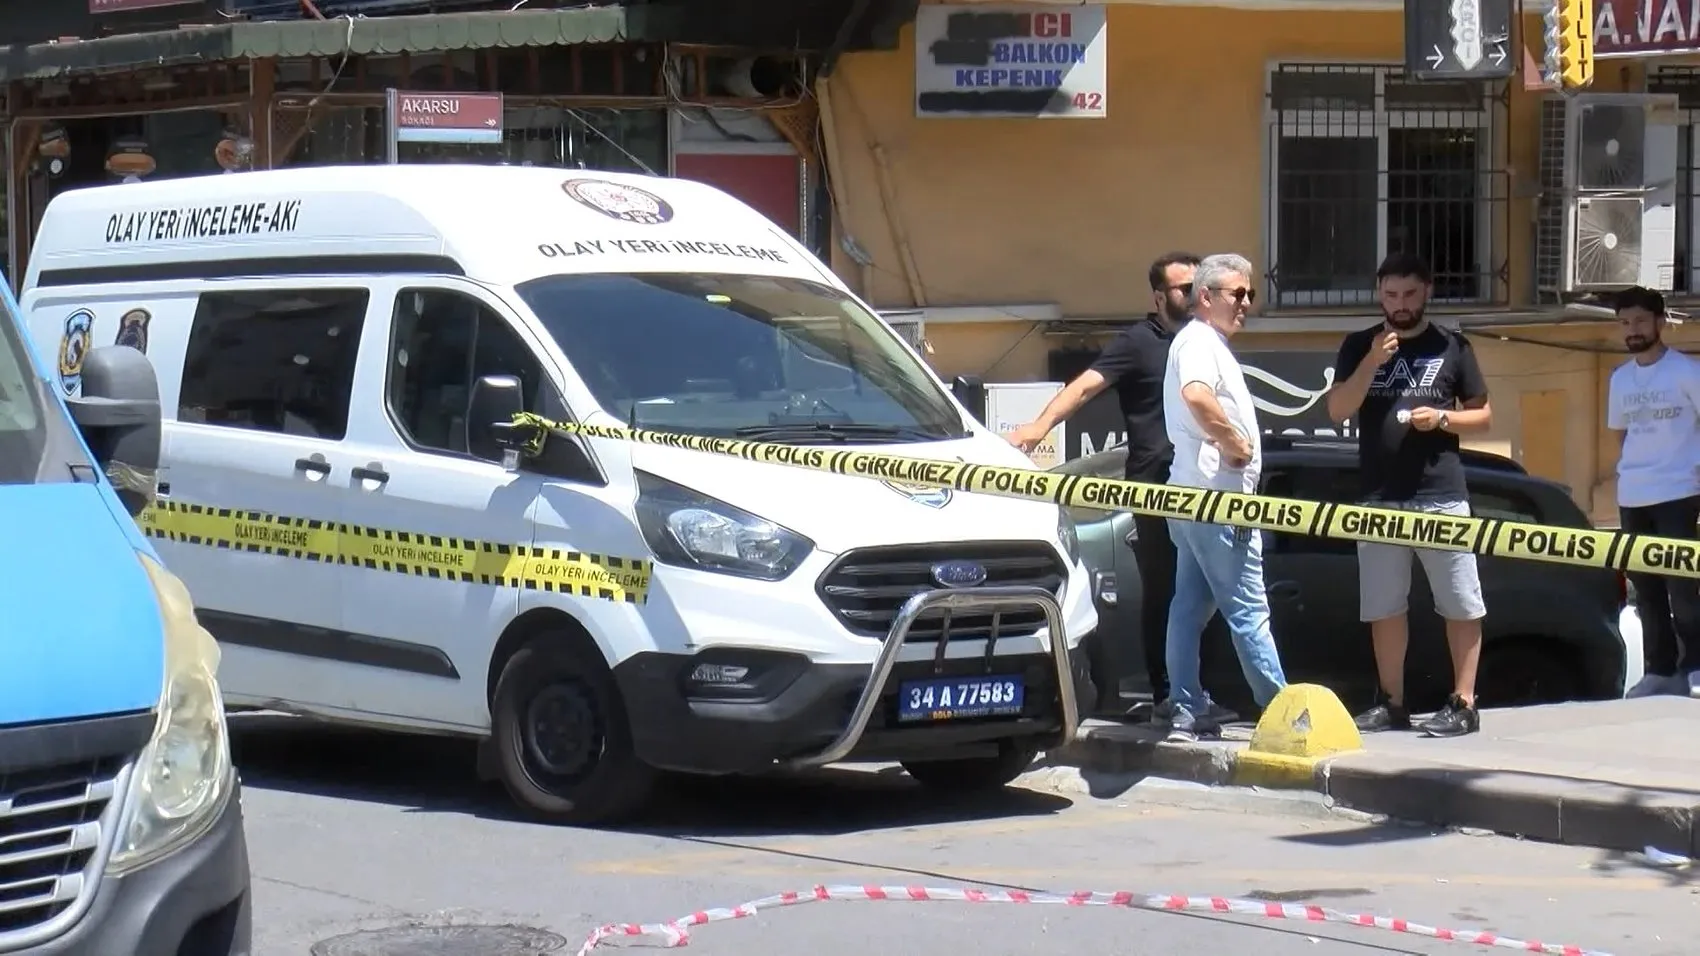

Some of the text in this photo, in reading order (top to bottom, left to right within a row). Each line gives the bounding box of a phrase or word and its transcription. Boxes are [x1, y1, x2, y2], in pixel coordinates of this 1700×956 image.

[995, 43, 1087, 64] BALKON
[956, 69, 1063, 87] KEPENK
[402, 100, 460, 114] AKARSU
[1073, 93, 1102, 110] 42
[106, 212, 147, 243] OLAY
[148, 208, 183, 240] YERİ
[537, 240, 606, 259] OLAY
[853, 455, 955, 485] GİRİLMEZ
[980, 470, 1049, 496] POLİS
[1081, 482, 1196, 514] GİRİLMEZ
[1226, 498, 1304, 527] POLİS
[1341, 510, 1472, 548] GİRİLMEZ
[1508, 528, 1597, 560] POLİS
[1642, 542, 1700, 573] GİR
[373, 544, 394, 557] OLAY
[535, 563, 559, 577] OLAY
[910, 681, 1015, 709] 34 A 77583
